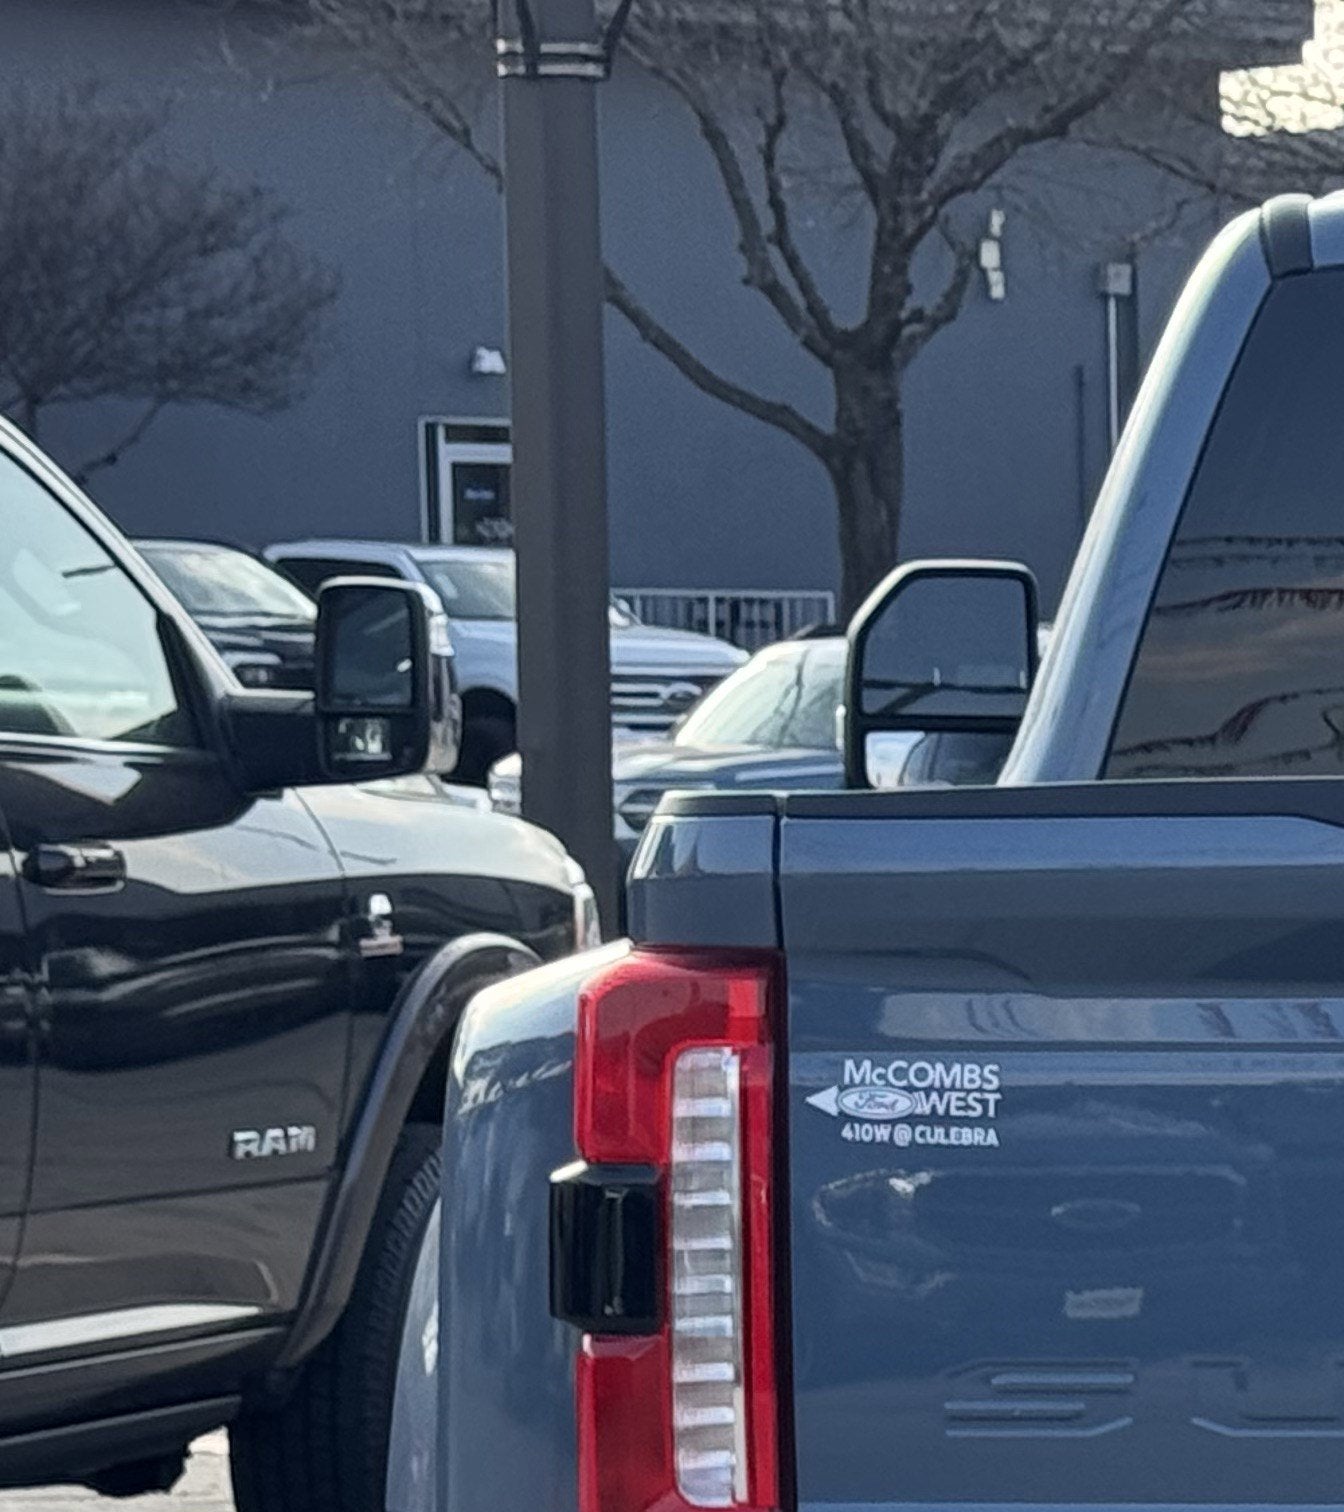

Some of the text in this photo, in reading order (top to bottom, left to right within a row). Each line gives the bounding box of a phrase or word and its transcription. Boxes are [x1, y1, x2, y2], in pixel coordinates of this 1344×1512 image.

[843, 1058, 1000, 1091] McCOMBS
[913, 1091, 1001, 1118] WEST
[233, 1125, 316, 1160] RAM
